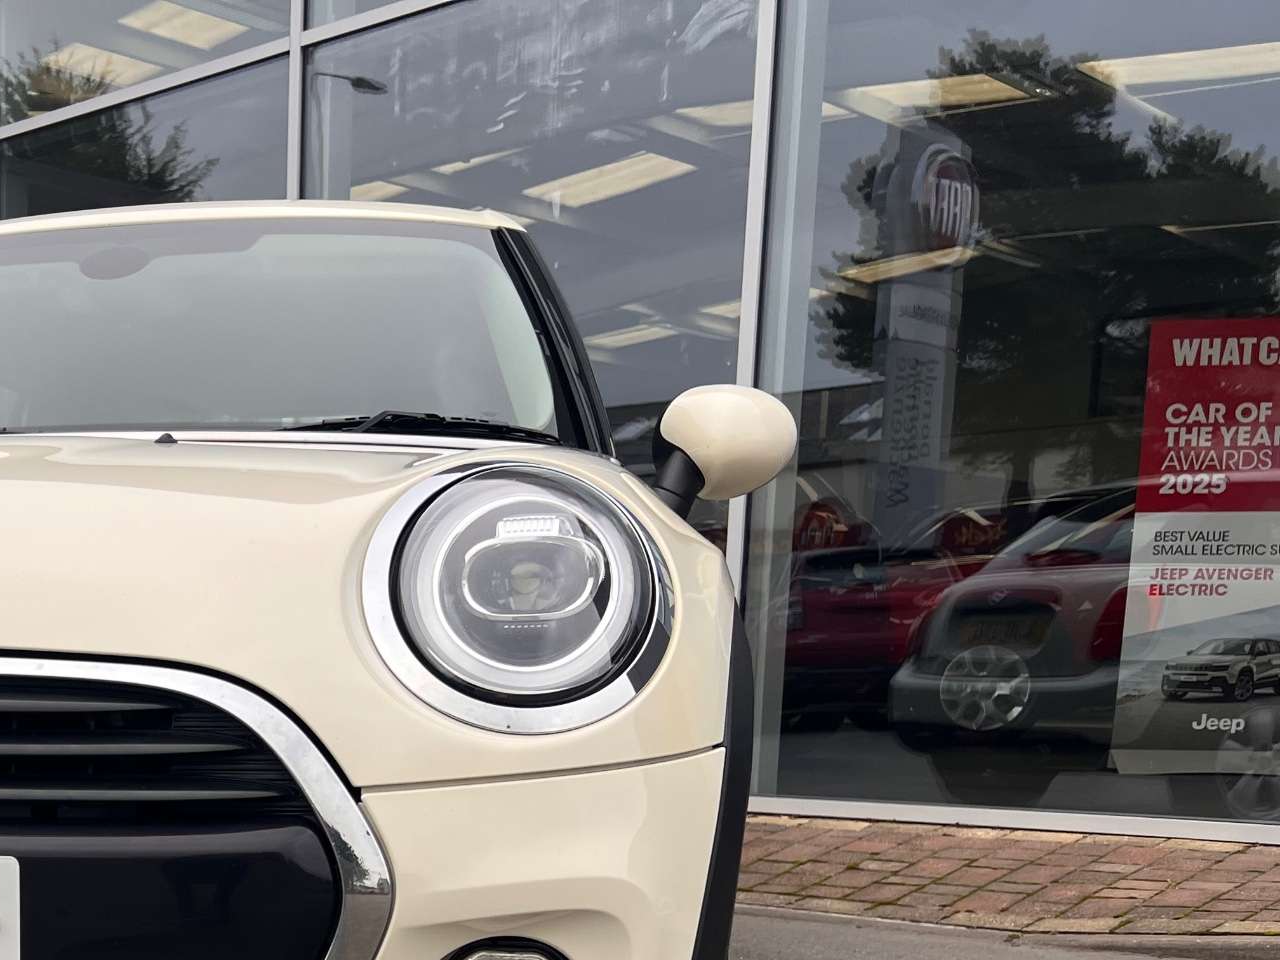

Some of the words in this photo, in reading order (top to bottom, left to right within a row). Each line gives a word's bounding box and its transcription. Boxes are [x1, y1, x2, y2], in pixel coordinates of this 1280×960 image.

[1172, 336, 1280, 367] WHATC
[1165, 403, 1227, 424] CAR
[1235, 402, 1273, 424] OF
[1164, 426, 1213, 448] THE
[1161, 449, 1273, 471] AWARDS
[1158, 473, 1228, 495] 2025
[1154, 531, 1185, 543] BEST
[1187, 530, 1230, 543] VALUE
[1152, 544, 1197, 556] SMALL
[1201, 544, 1267, 556] ELECTRIC
[1150, 568, 1188, 580] JEEP
[1193, 568, 1274, 580] AVENGER
[1149, 584, 1228, 596] ELECTRIC
[1192, 713, 1245, 734] Jeep
